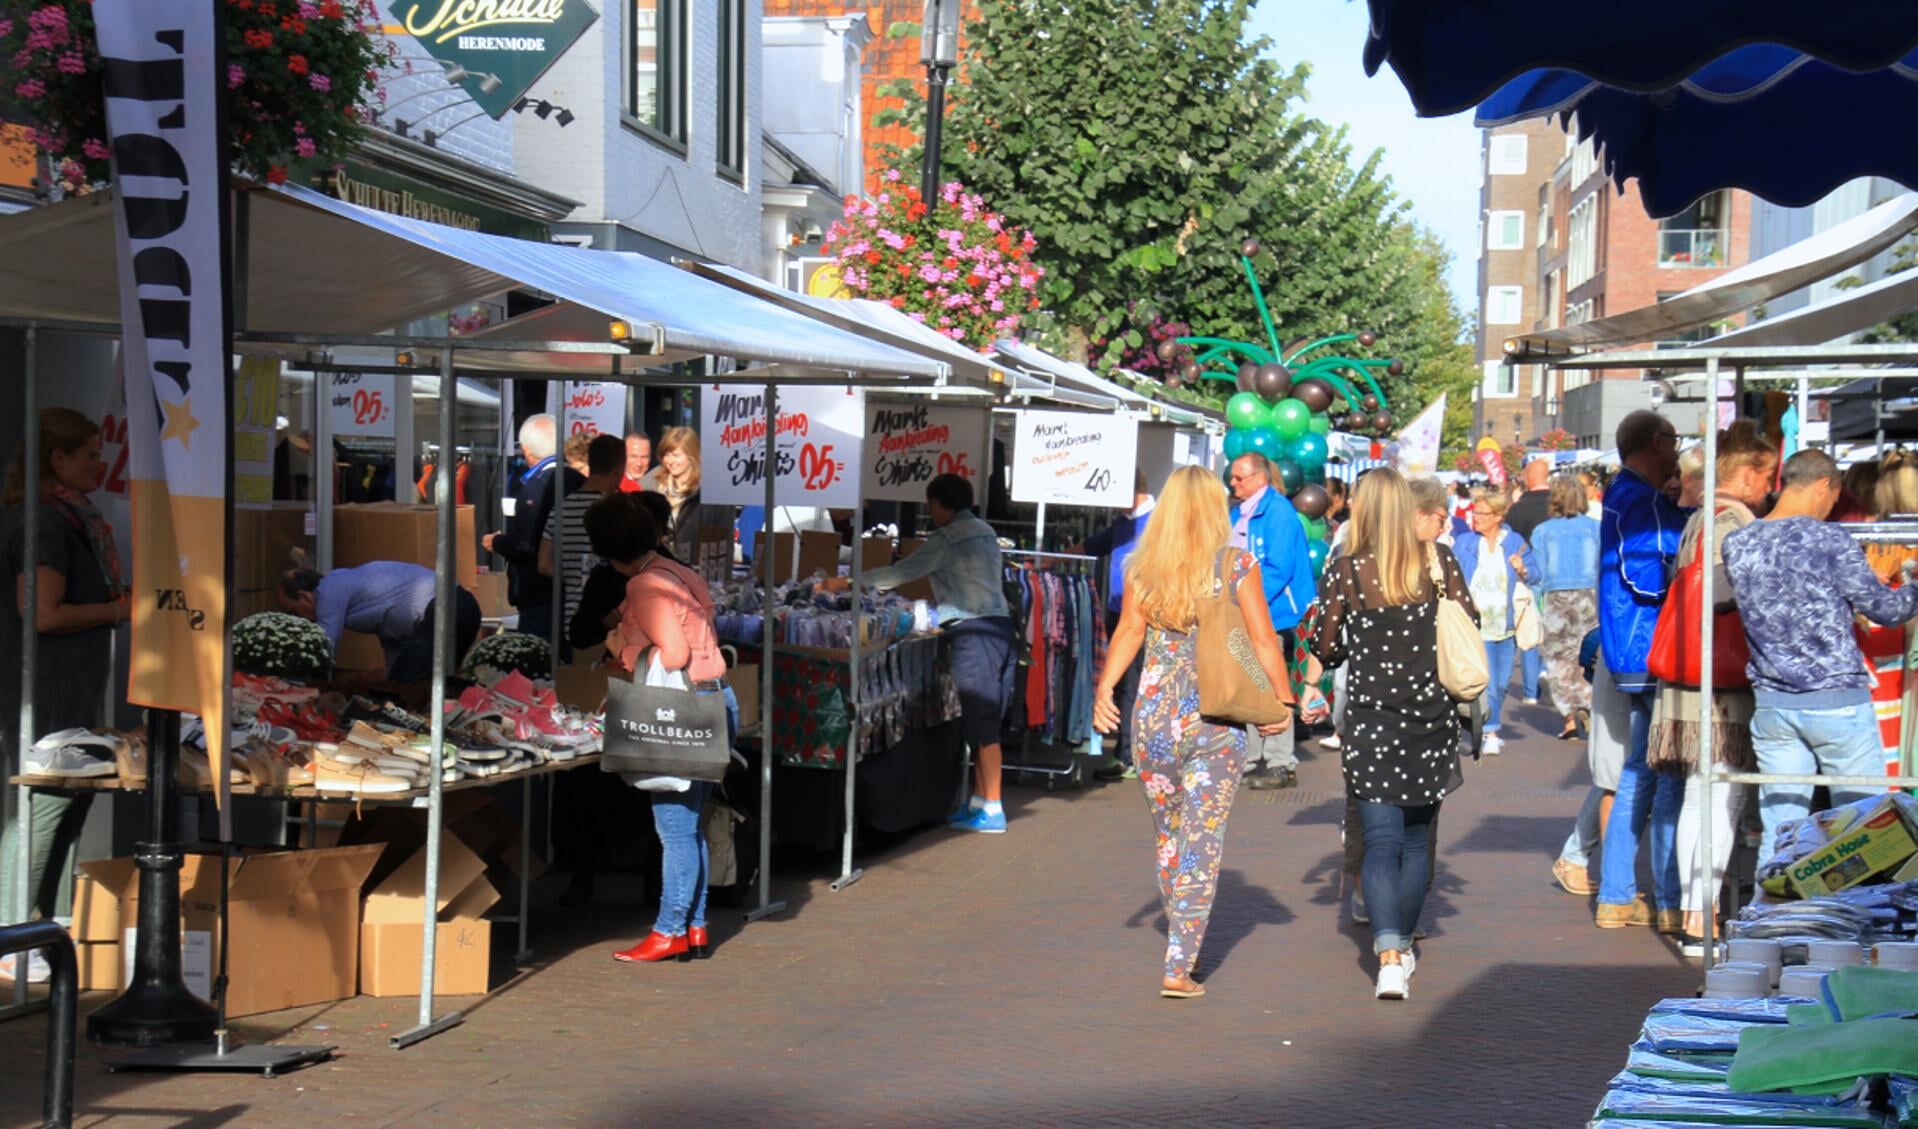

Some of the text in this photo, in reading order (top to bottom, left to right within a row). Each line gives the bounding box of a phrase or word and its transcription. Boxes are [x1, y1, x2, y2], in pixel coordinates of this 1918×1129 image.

[458, 36, 545, 51] HERENMODE
[871, 405, 929, 435] Markt
[620, 719, 713, 739] TROLLBEADS
[1794, 854, 1837, 881] Cobra
[1835, 833, 1871, 857] Hose
